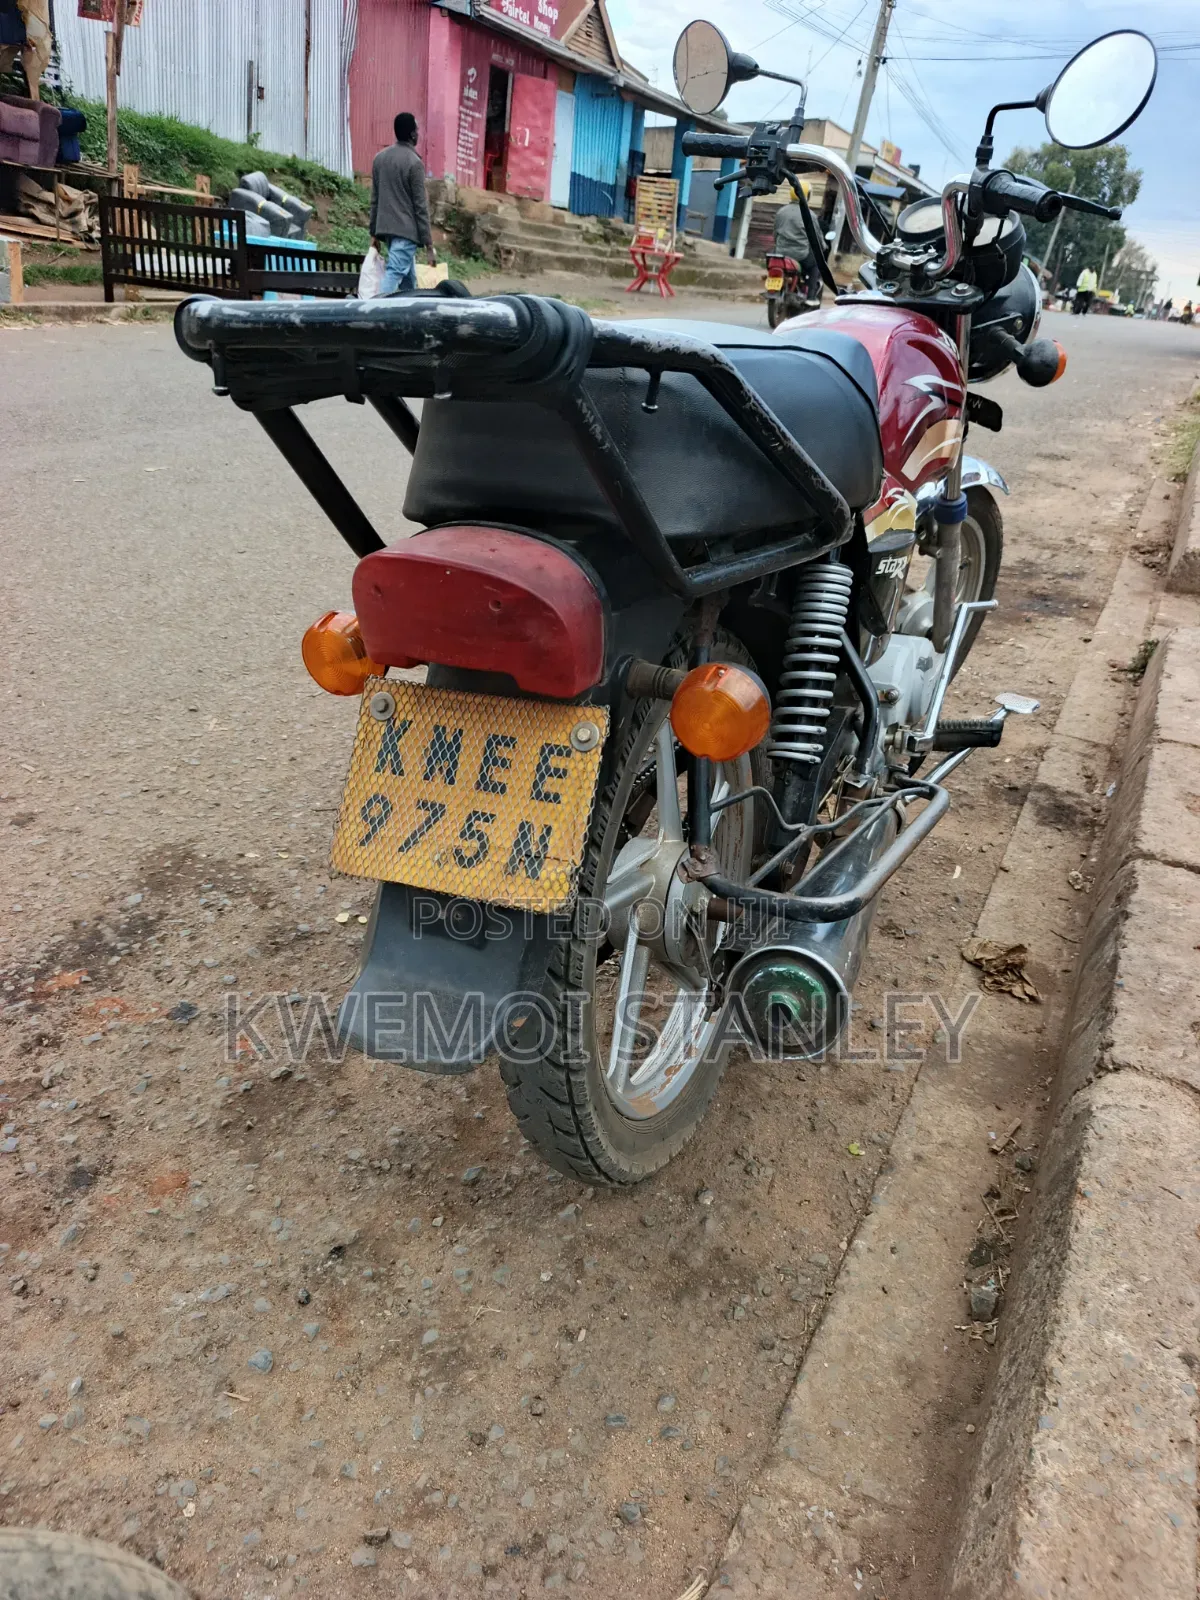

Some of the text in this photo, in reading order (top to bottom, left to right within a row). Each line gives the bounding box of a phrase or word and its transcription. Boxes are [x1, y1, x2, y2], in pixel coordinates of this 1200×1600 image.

[507, 3, 530, 25] airtel
[538, 0, 559, 25] Shop
[374, 718, 573, 804] KMEE
[358, 794, 553, 880] 975N
